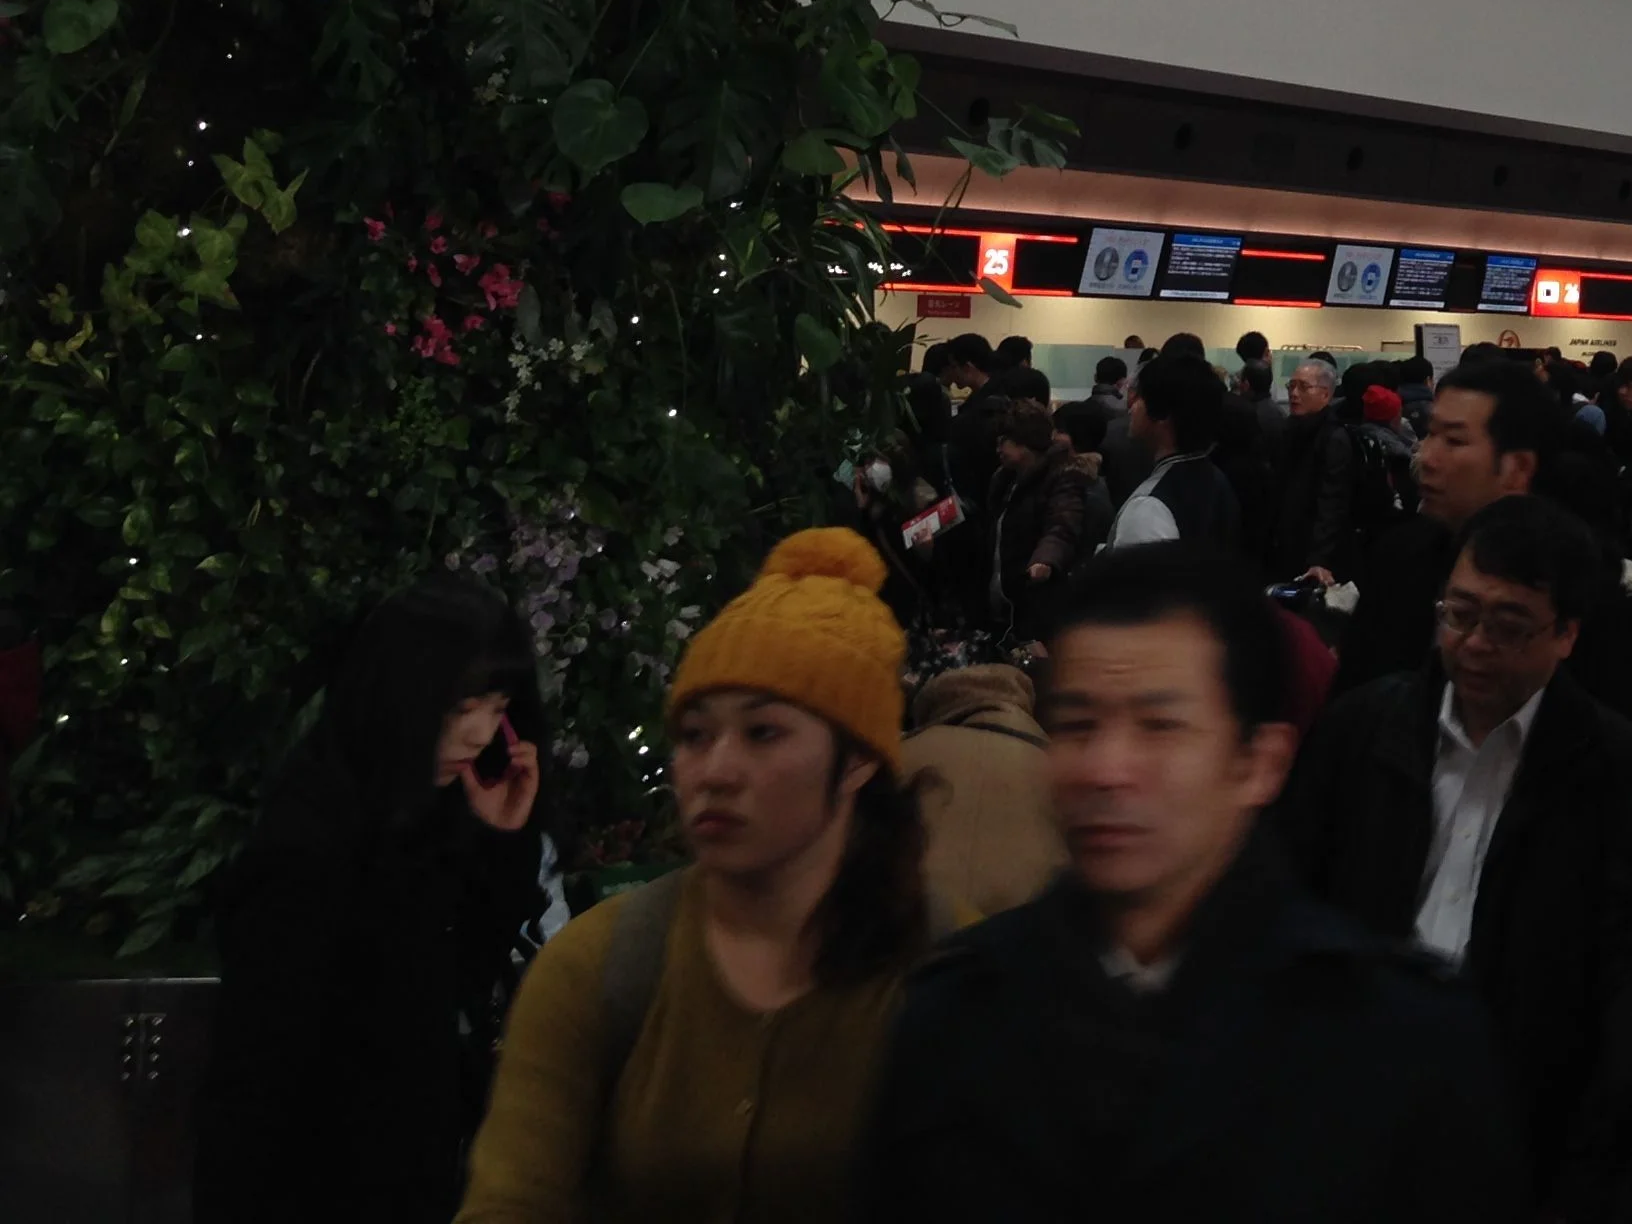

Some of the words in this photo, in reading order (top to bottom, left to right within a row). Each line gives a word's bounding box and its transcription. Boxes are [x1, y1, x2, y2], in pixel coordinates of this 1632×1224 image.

[983, 248, 1009, 275] 25
[1569, 338, 1588, 347] JAPAN
[1589, 339, 1618, 347] AIRLINES
